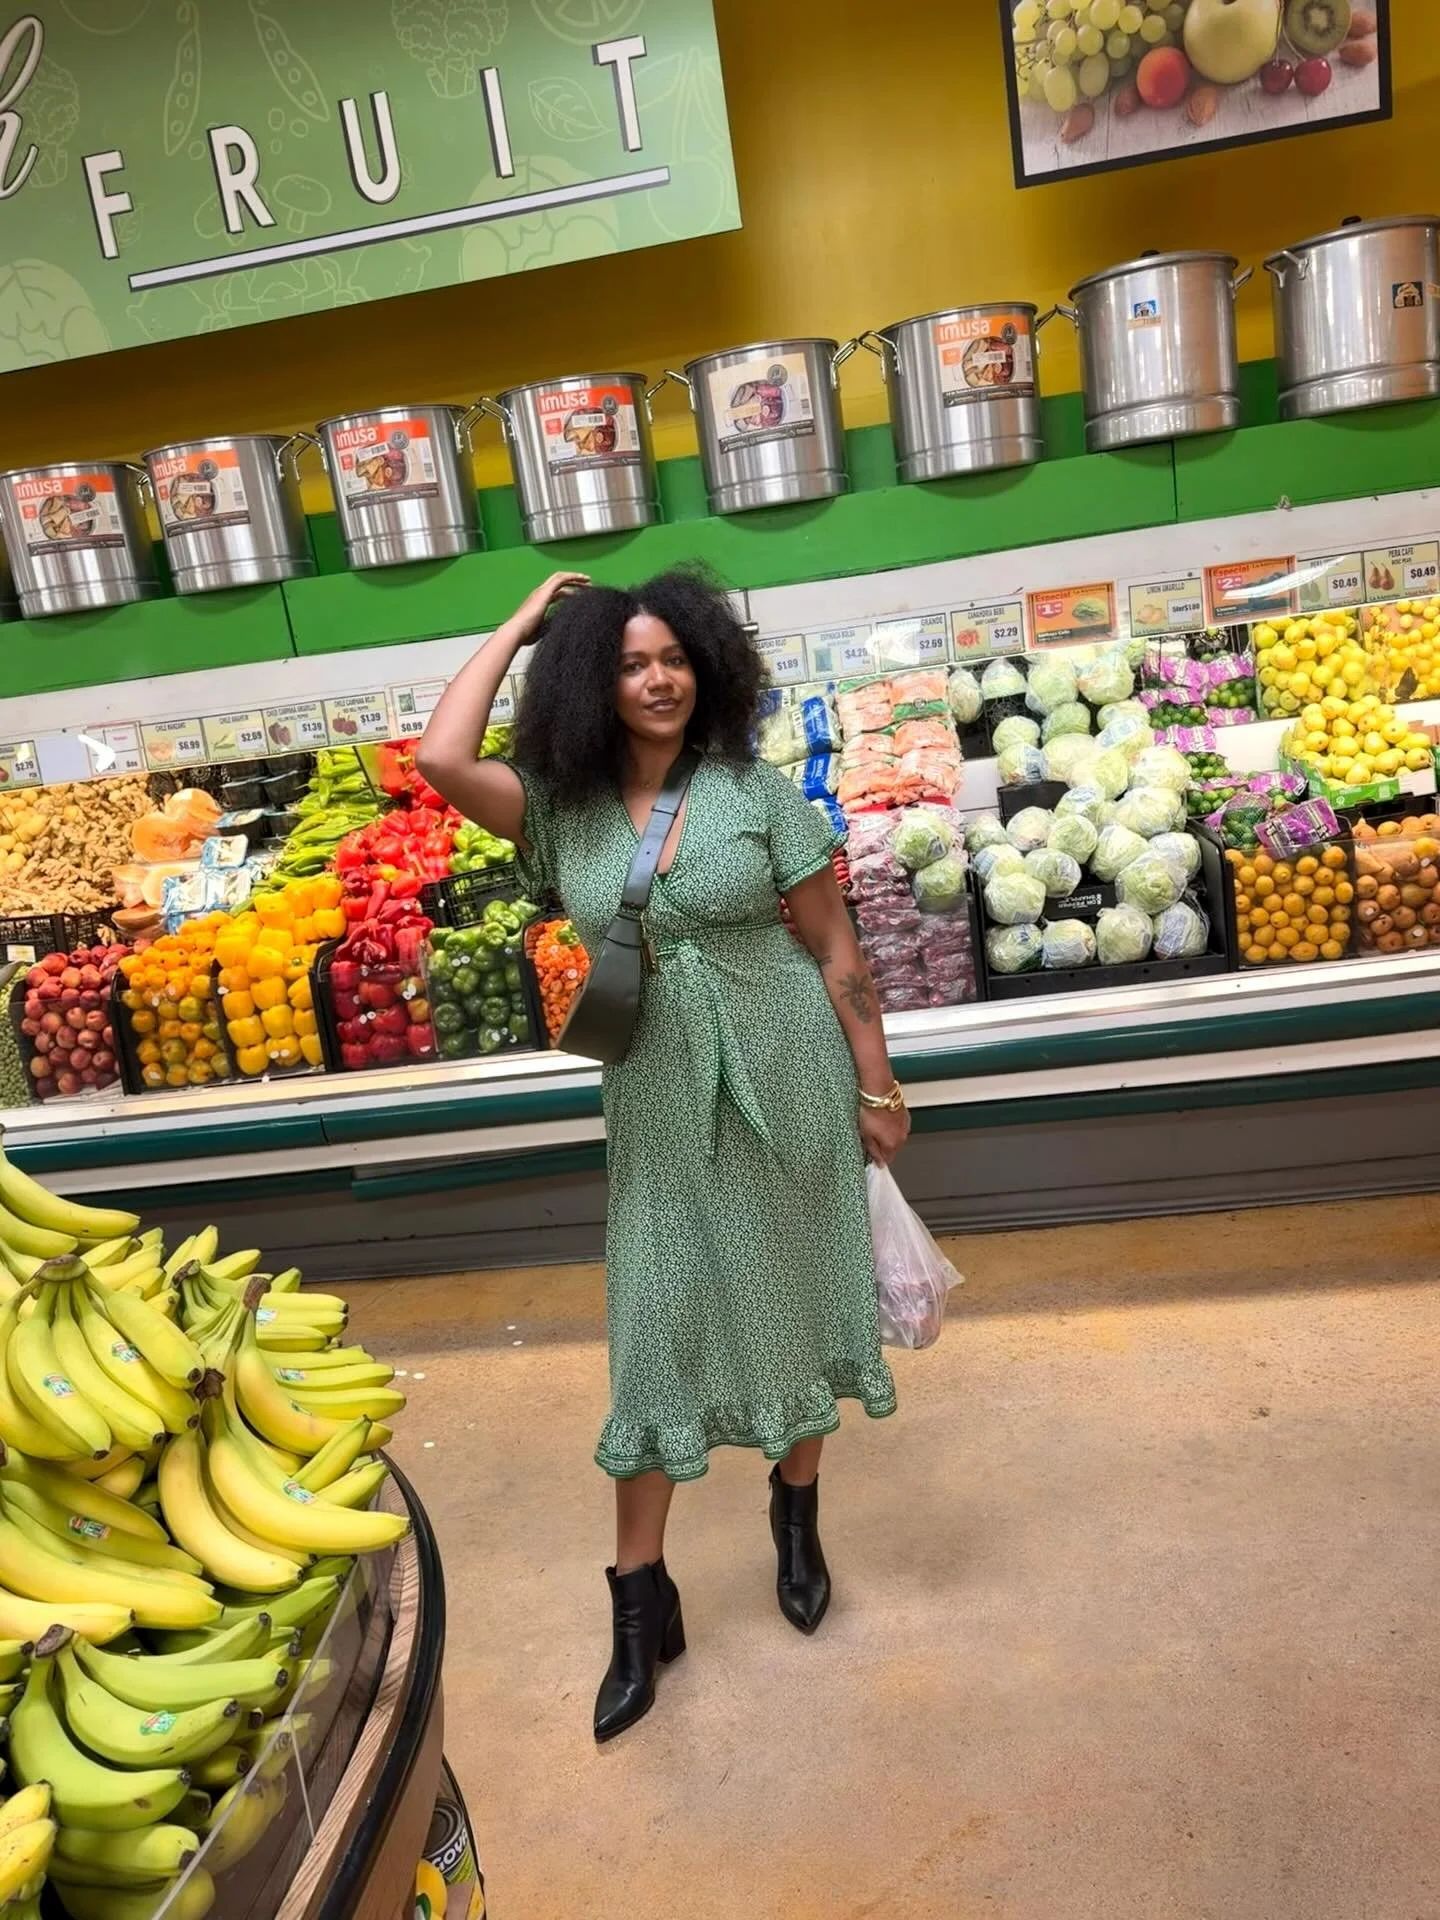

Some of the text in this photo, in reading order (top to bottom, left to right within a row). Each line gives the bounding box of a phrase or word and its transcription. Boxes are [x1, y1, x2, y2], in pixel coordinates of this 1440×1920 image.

[82, 35, 647, 259] FRUIT
[939, 319, 991, 341] imusa
[541, 390, 588, 412] imusa
[336, 426, 378, 449] imusa
[17, 479, 63, 498] imusa
[1410, 565, 1436, 580] $0.49
[1332, 577, 1358, 589] $0.49
[920, 616, 943, 626] GRANDE
[994, 626, 1018, 639] $2.29
[776, 658, 799, 671] $1.89
[360, 712, 381, 724] $1.39
[302, 721, 322, 733] $1.39
[401, 721, 423, 733] $0.99
[178, 740, 200, 751] $6.99
